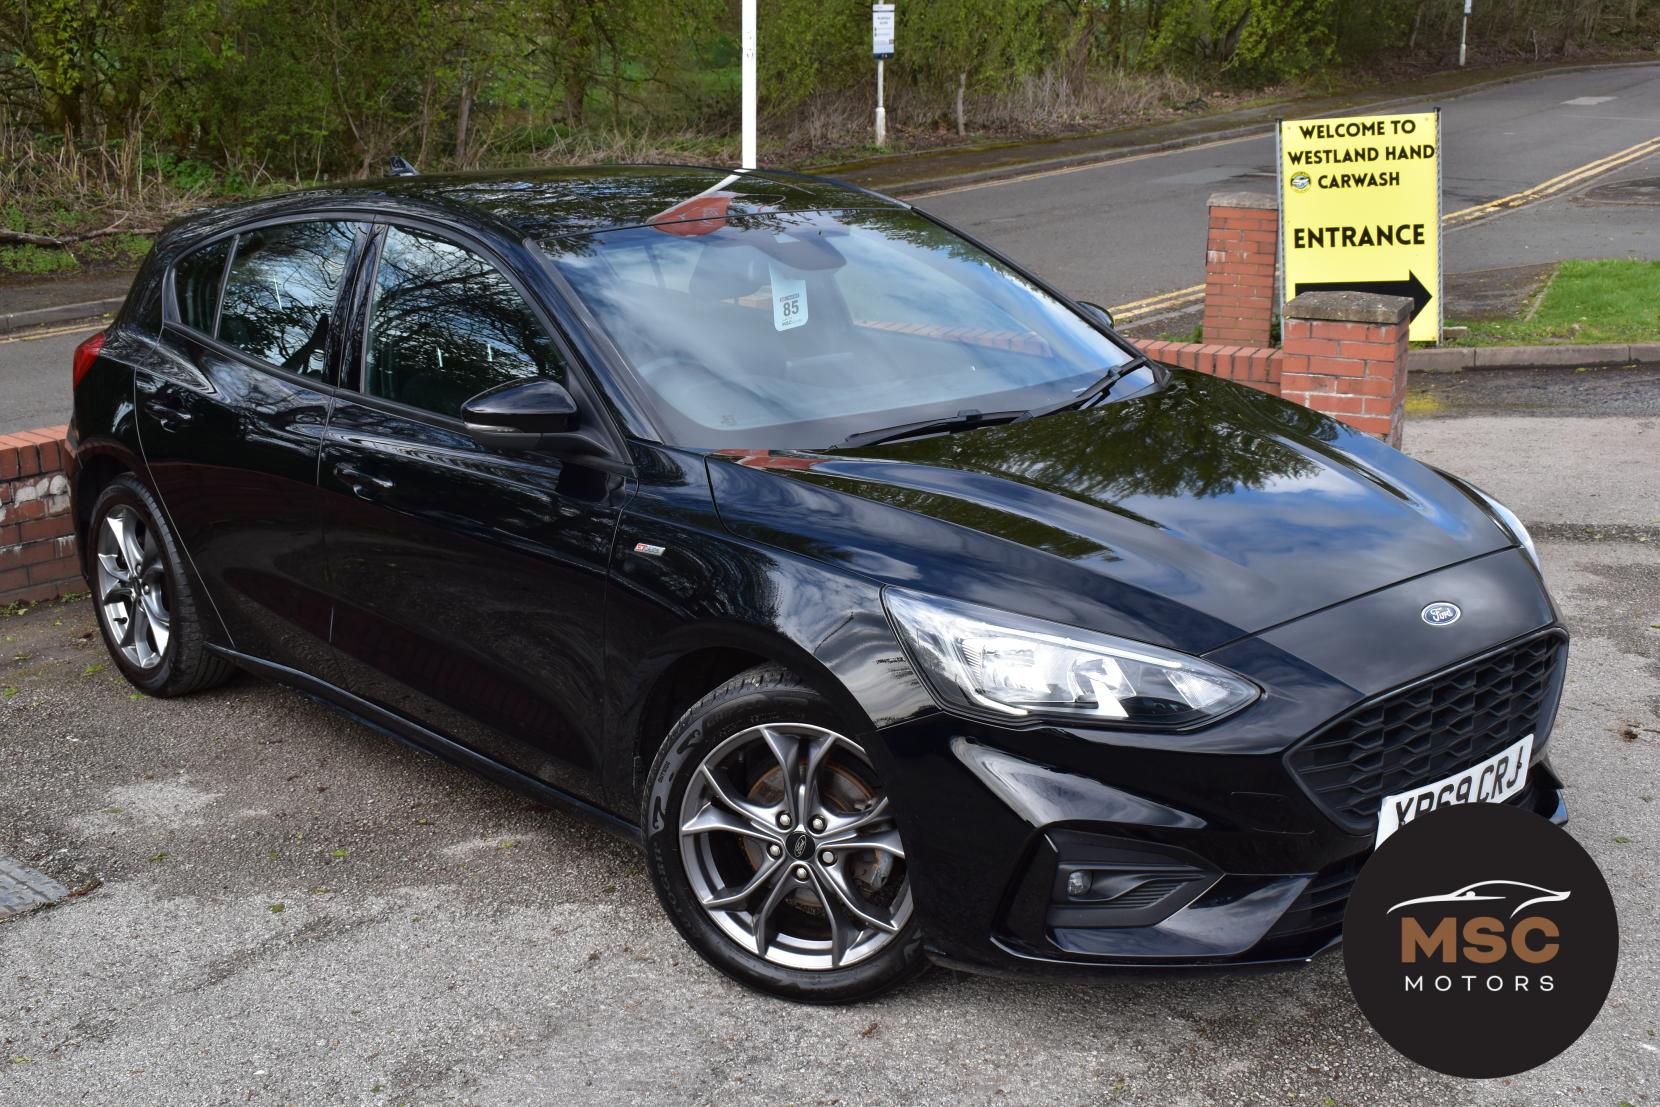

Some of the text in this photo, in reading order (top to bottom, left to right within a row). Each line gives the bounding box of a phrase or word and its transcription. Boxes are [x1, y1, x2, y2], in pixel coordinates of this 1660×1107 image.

[1298, 119, 1416, 139] WELCOME TO
[1288, 144, 1435, 165] WESTLAND HAND
[1317, 172, 1400, 189] CARWASH
[1294, 224, 1425, 249] ENTRANCE
[783, 300, 799, 316] 85
[1430, 607, 1454, 621] Ford
[1477, 746, 1524, 802] CRJ
